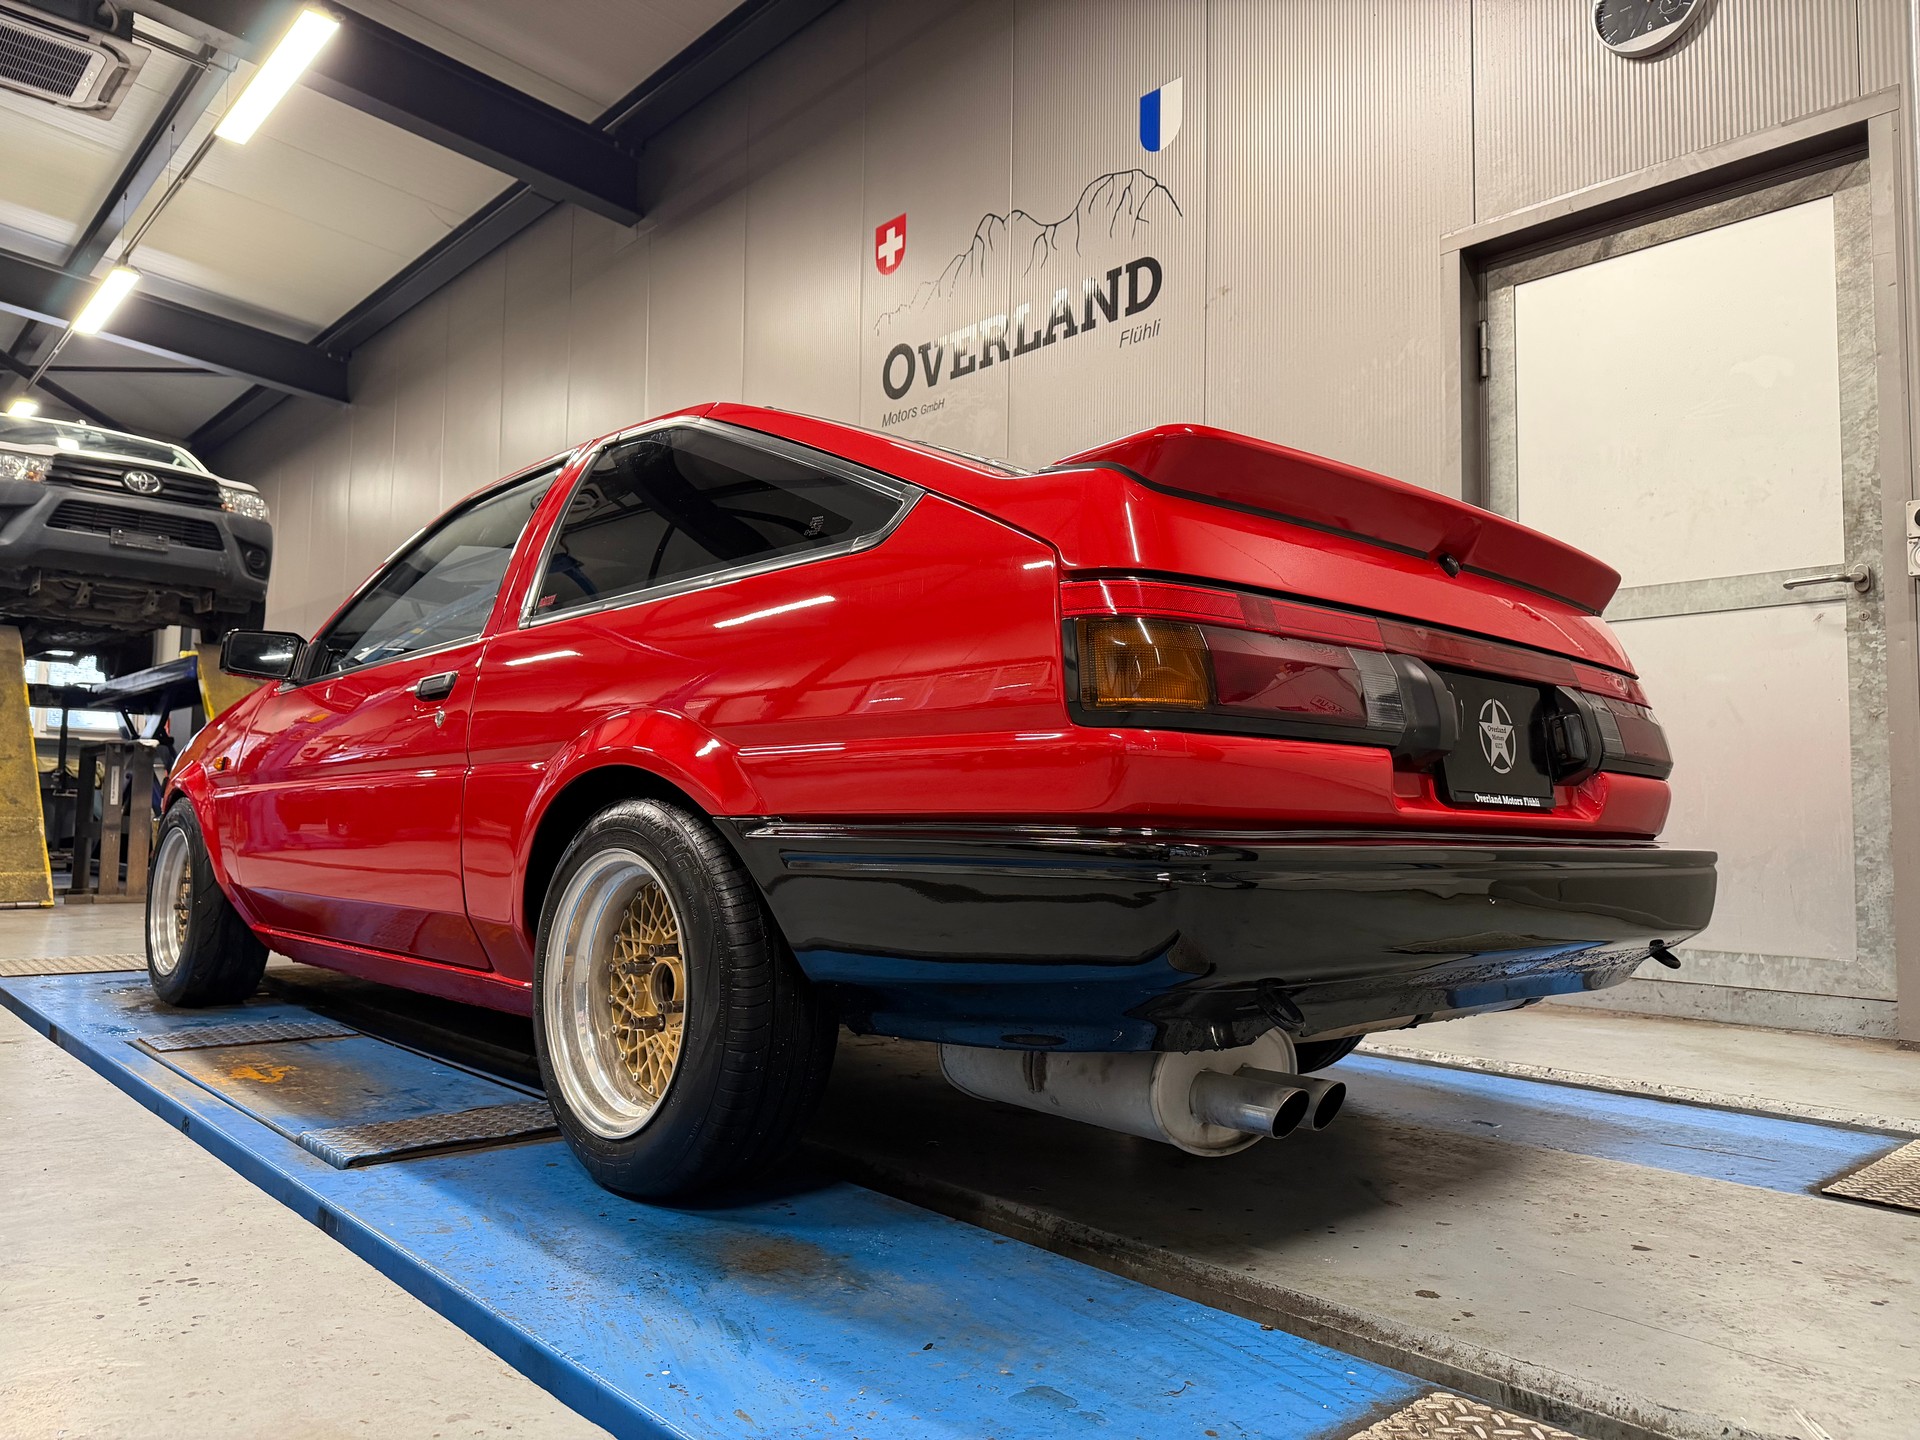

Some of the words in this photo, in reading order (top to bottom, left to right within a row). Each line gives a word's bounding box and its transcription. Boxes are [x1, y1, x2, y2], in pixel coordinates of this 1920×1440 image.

[1647, 21, 1653, 31] 6
[882, 256, 1163, 400] OVERLAND
[1119, 318, 1161, 349] Flühli
[881, 405, 917, 428] Motors
[920, 398, 945, 416] GmbH
[1474, 793, 1502, 804] Overland
[1502, 795, 1523, 805] Motors
